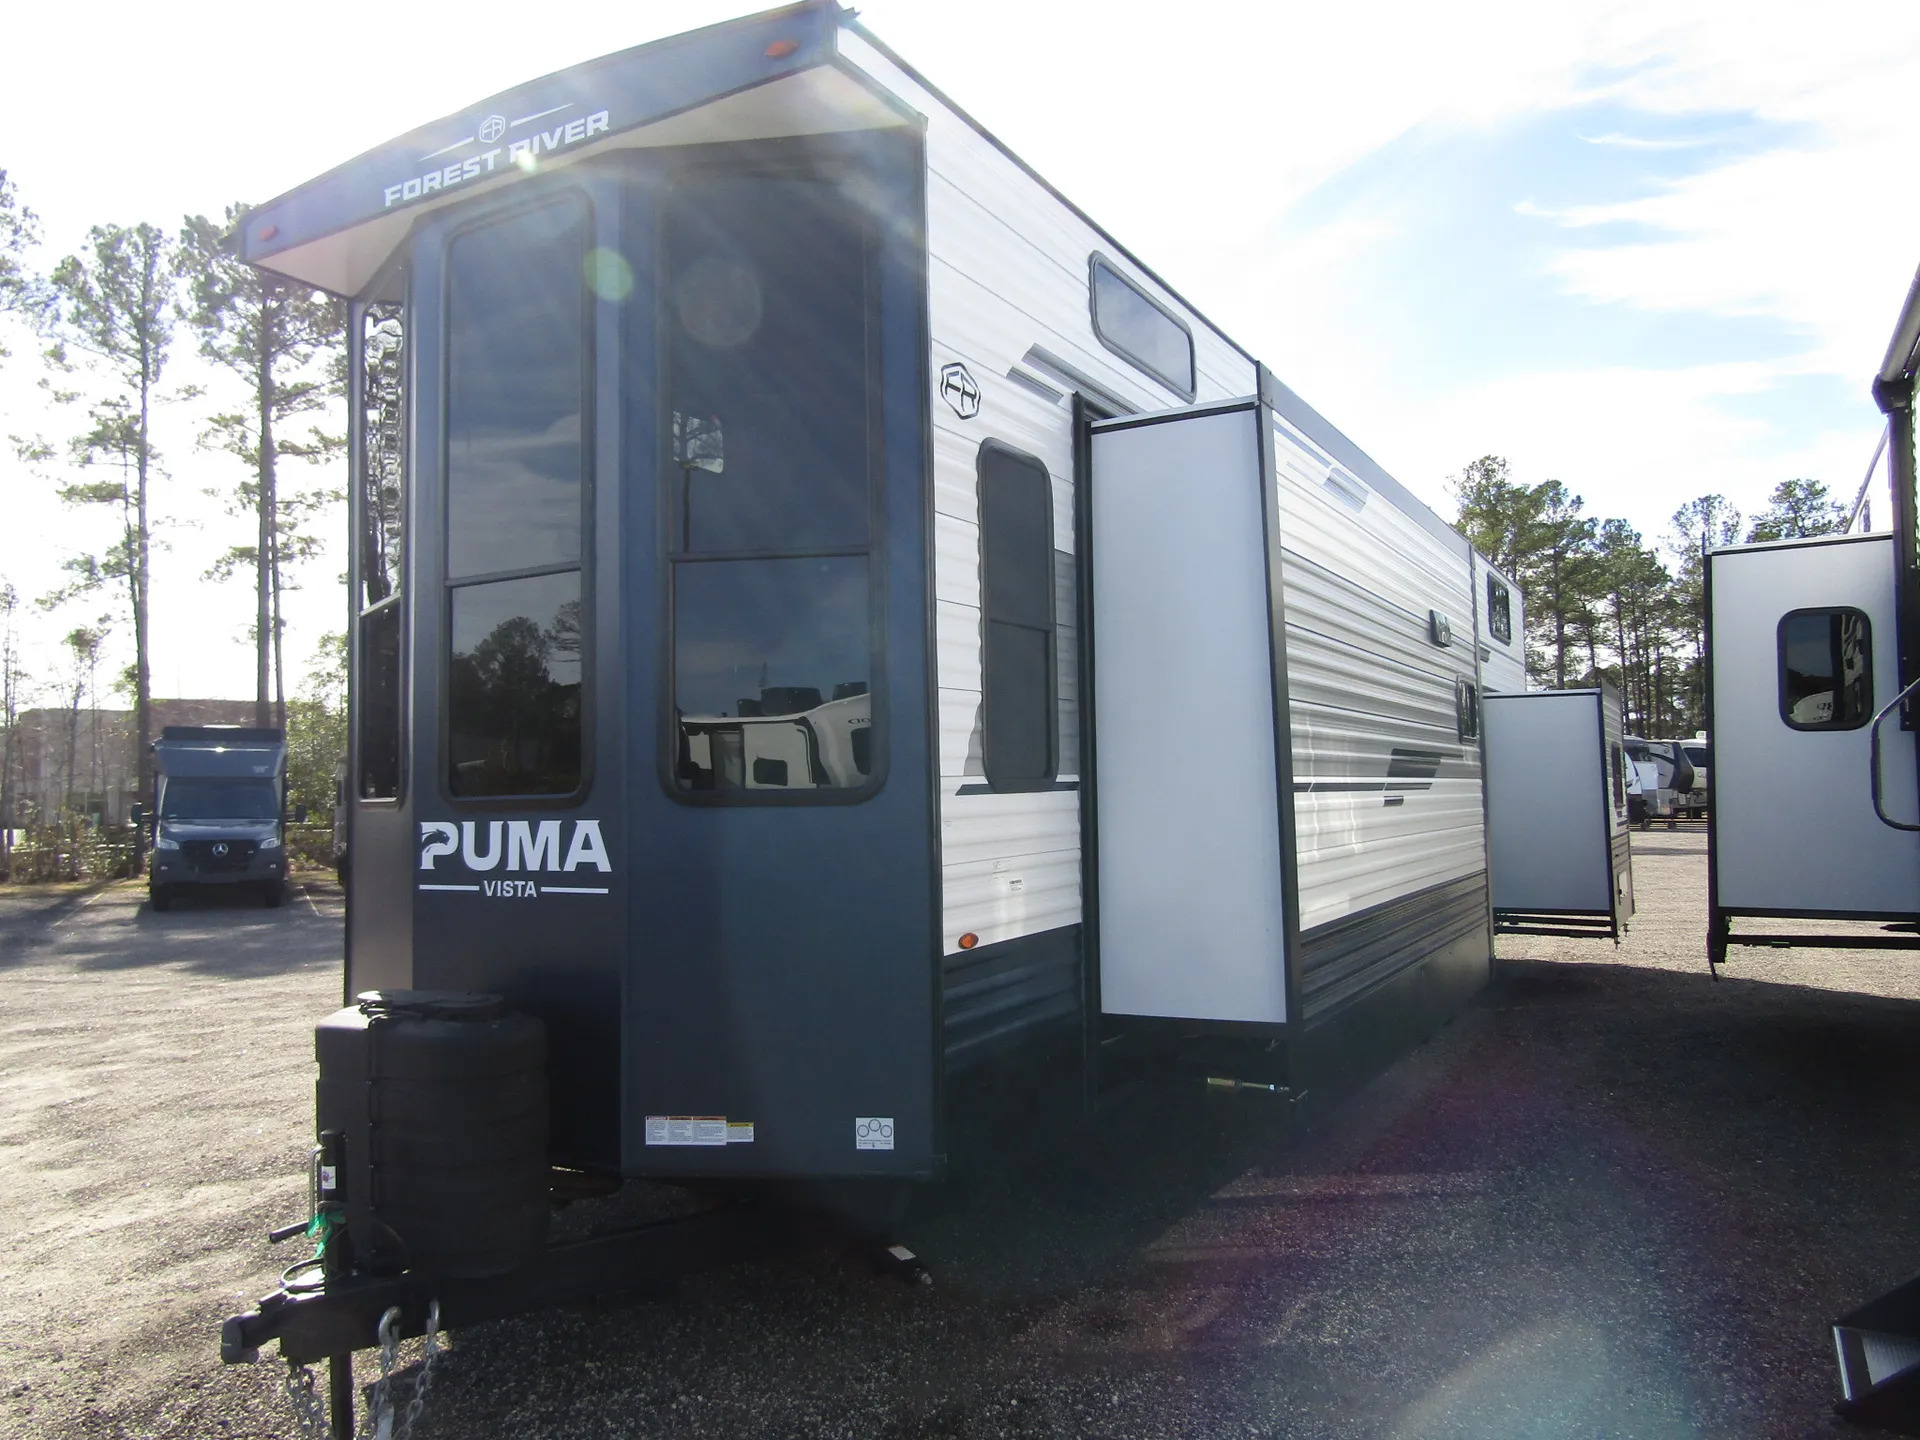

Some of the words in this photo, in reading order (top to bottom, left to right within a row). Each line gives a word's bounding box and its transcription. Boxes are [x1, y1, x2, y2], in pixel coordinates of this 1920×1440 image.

[384, 148, 501, 207] FOREST
[508, 110, 610, 164] RIVER
[420, 819, 612, 872] PUMA
[483, 880, 537, 897] VISTA
